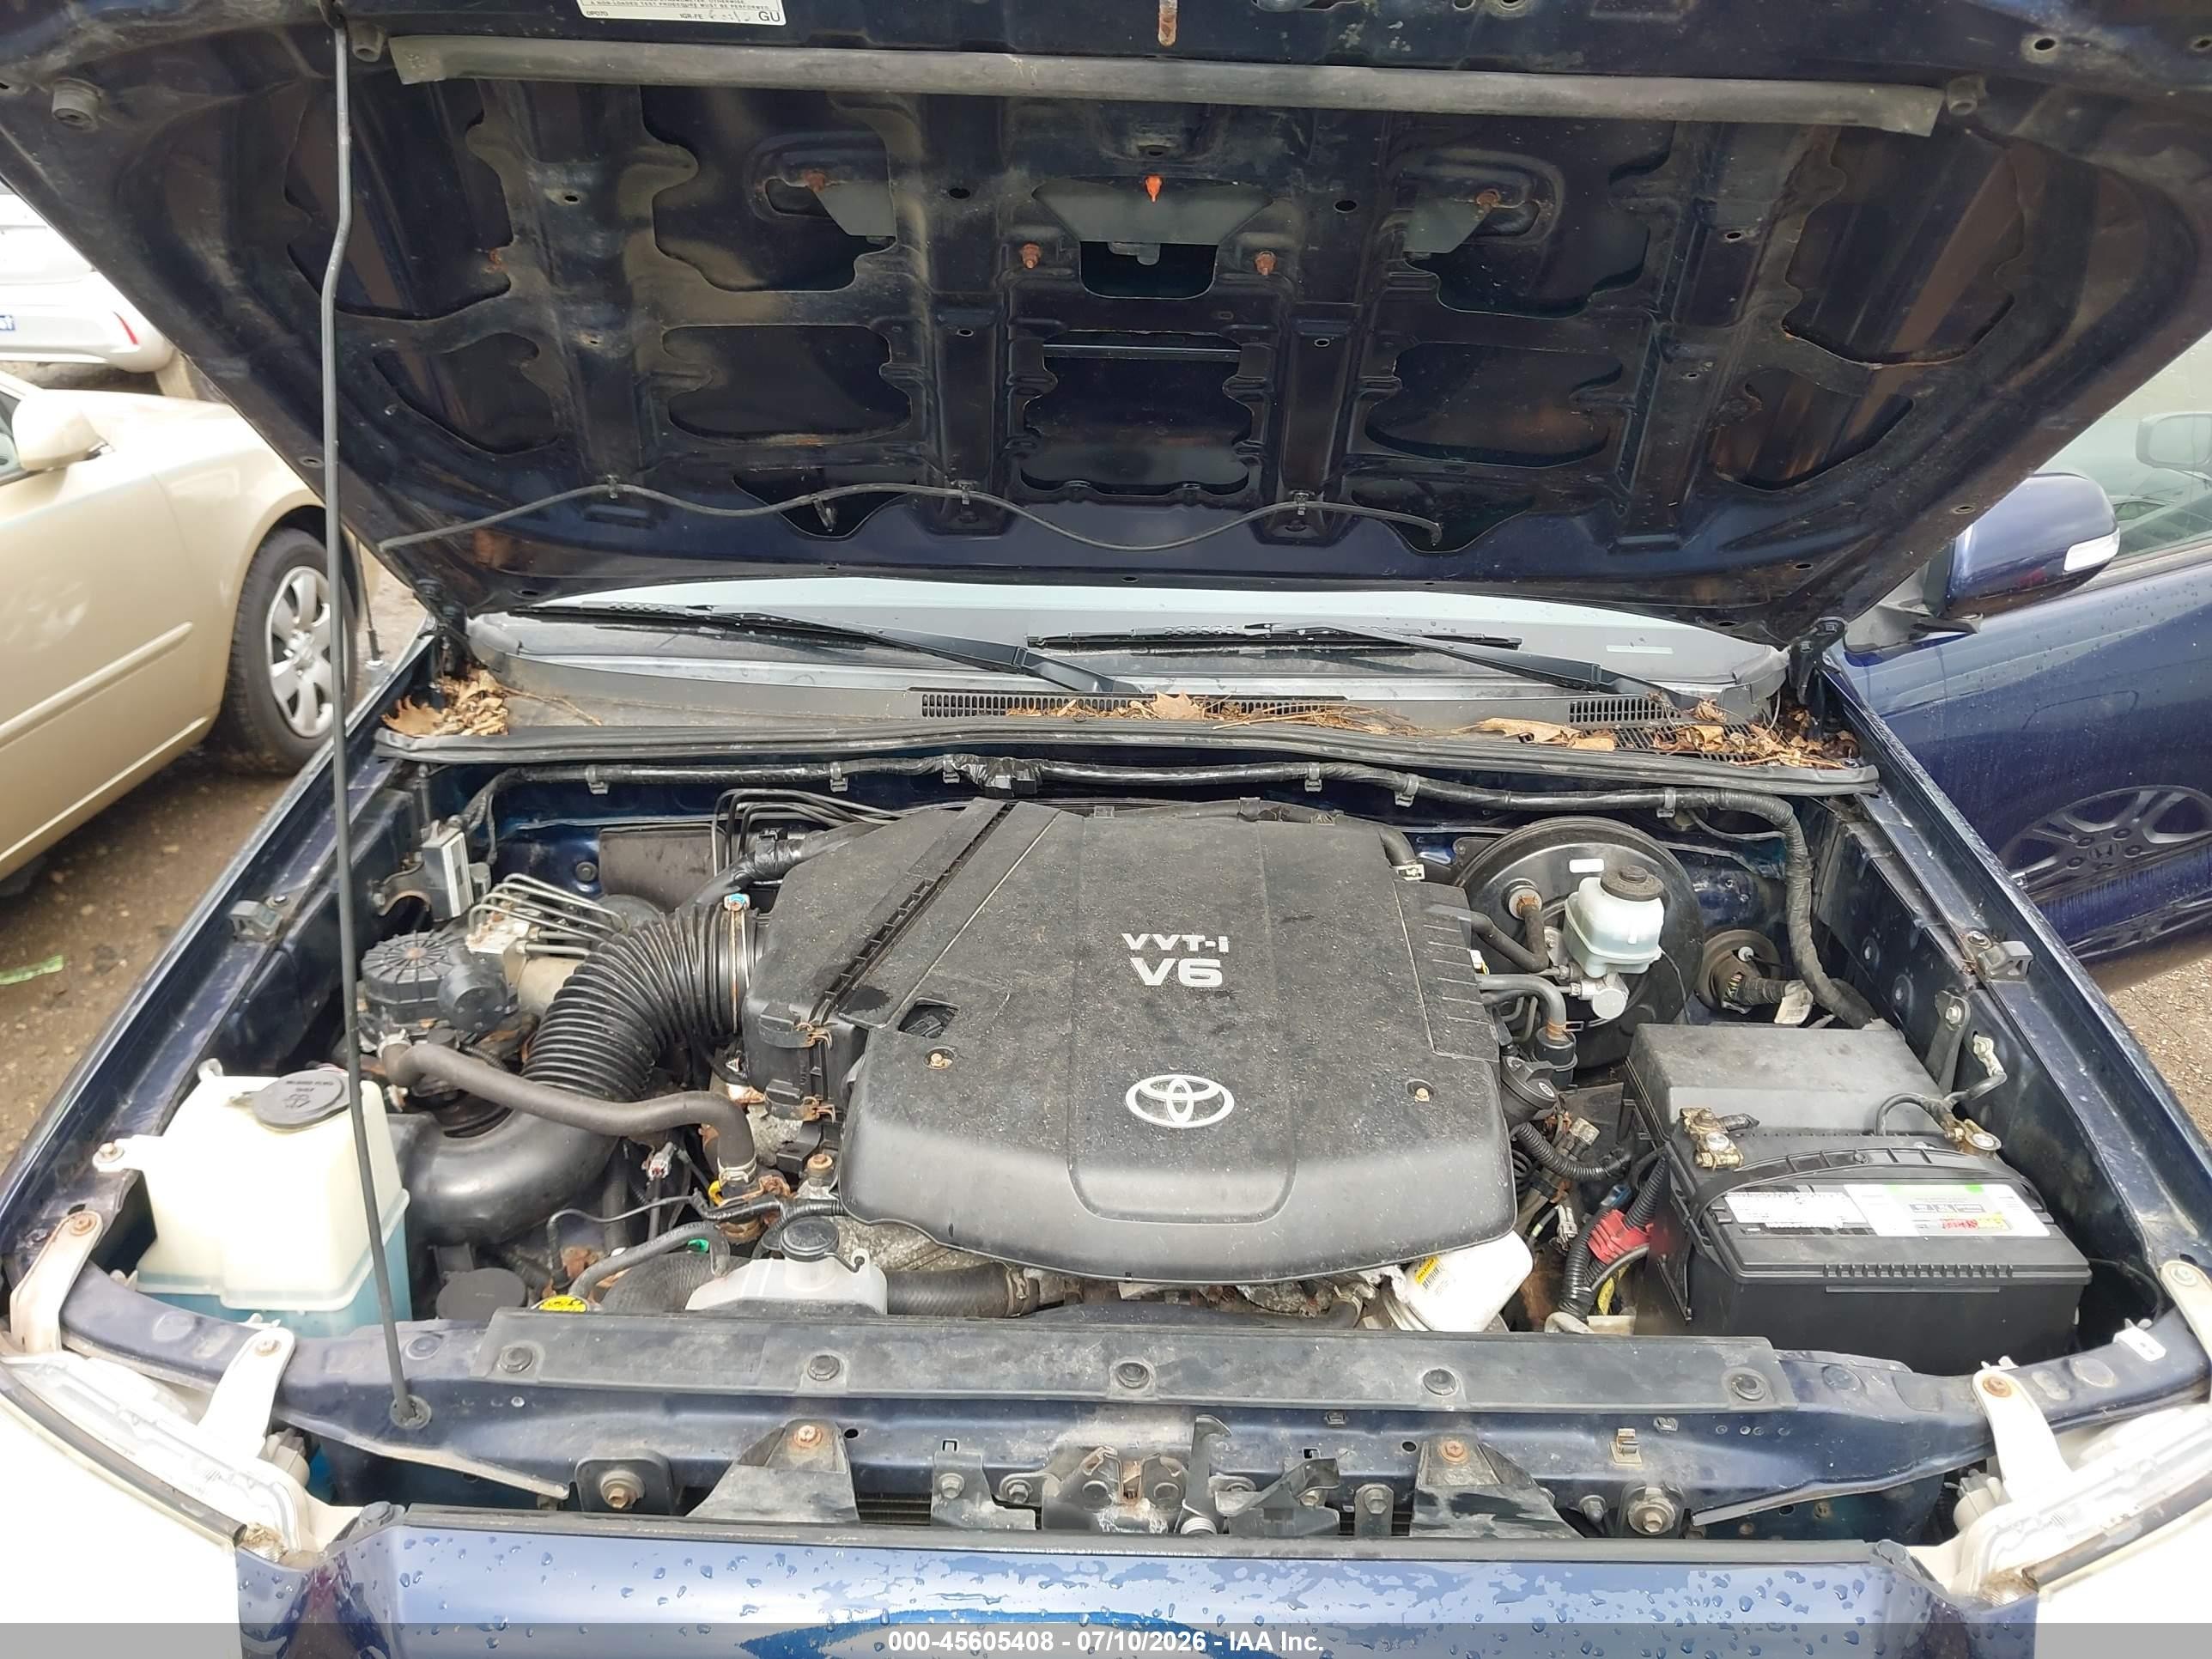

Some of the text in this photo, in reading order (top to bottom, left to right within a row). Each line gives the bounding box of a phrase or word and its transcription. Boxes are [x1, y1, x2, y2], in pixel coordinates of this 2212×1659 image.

[758, 11, 781, 21] GU
[1121, 933, 1230, 953] VVT-i
[1128, 957, 1223, 988] V6
